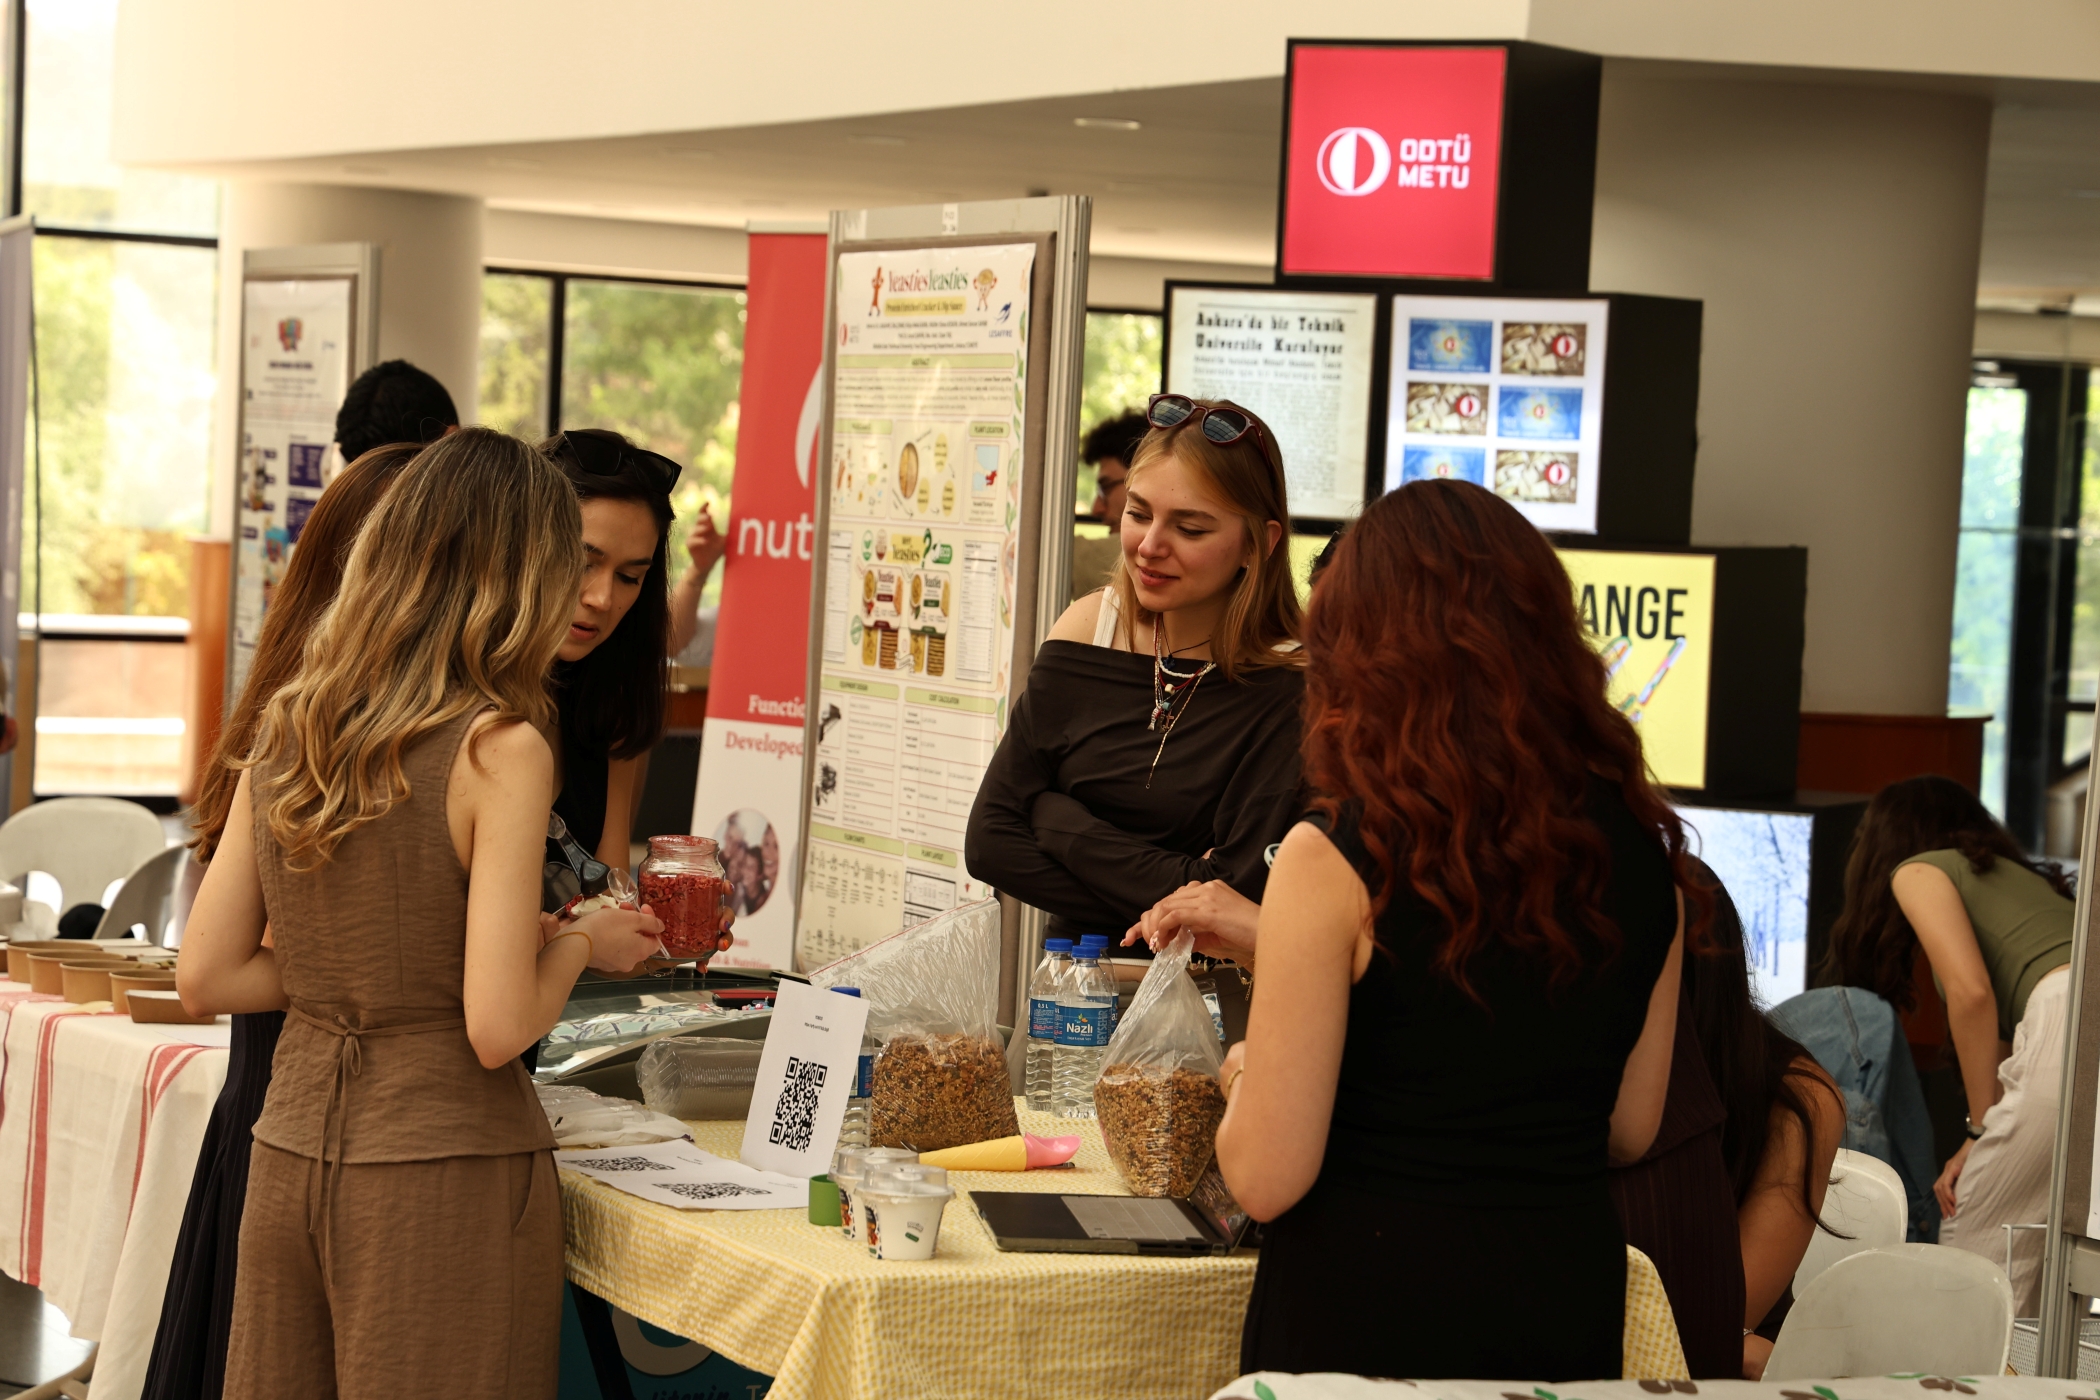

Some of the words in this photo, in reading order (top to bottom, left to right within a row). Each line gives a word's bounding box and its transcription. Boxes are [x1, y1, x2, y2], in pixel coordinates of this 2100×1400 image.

[1400, 133, 1471, 163] ODTÜ
[1398, 164, 1470, 189] METU
[1271, 316, 1290, 330] bir
[1299, 316, 1345, 332] Teknik
